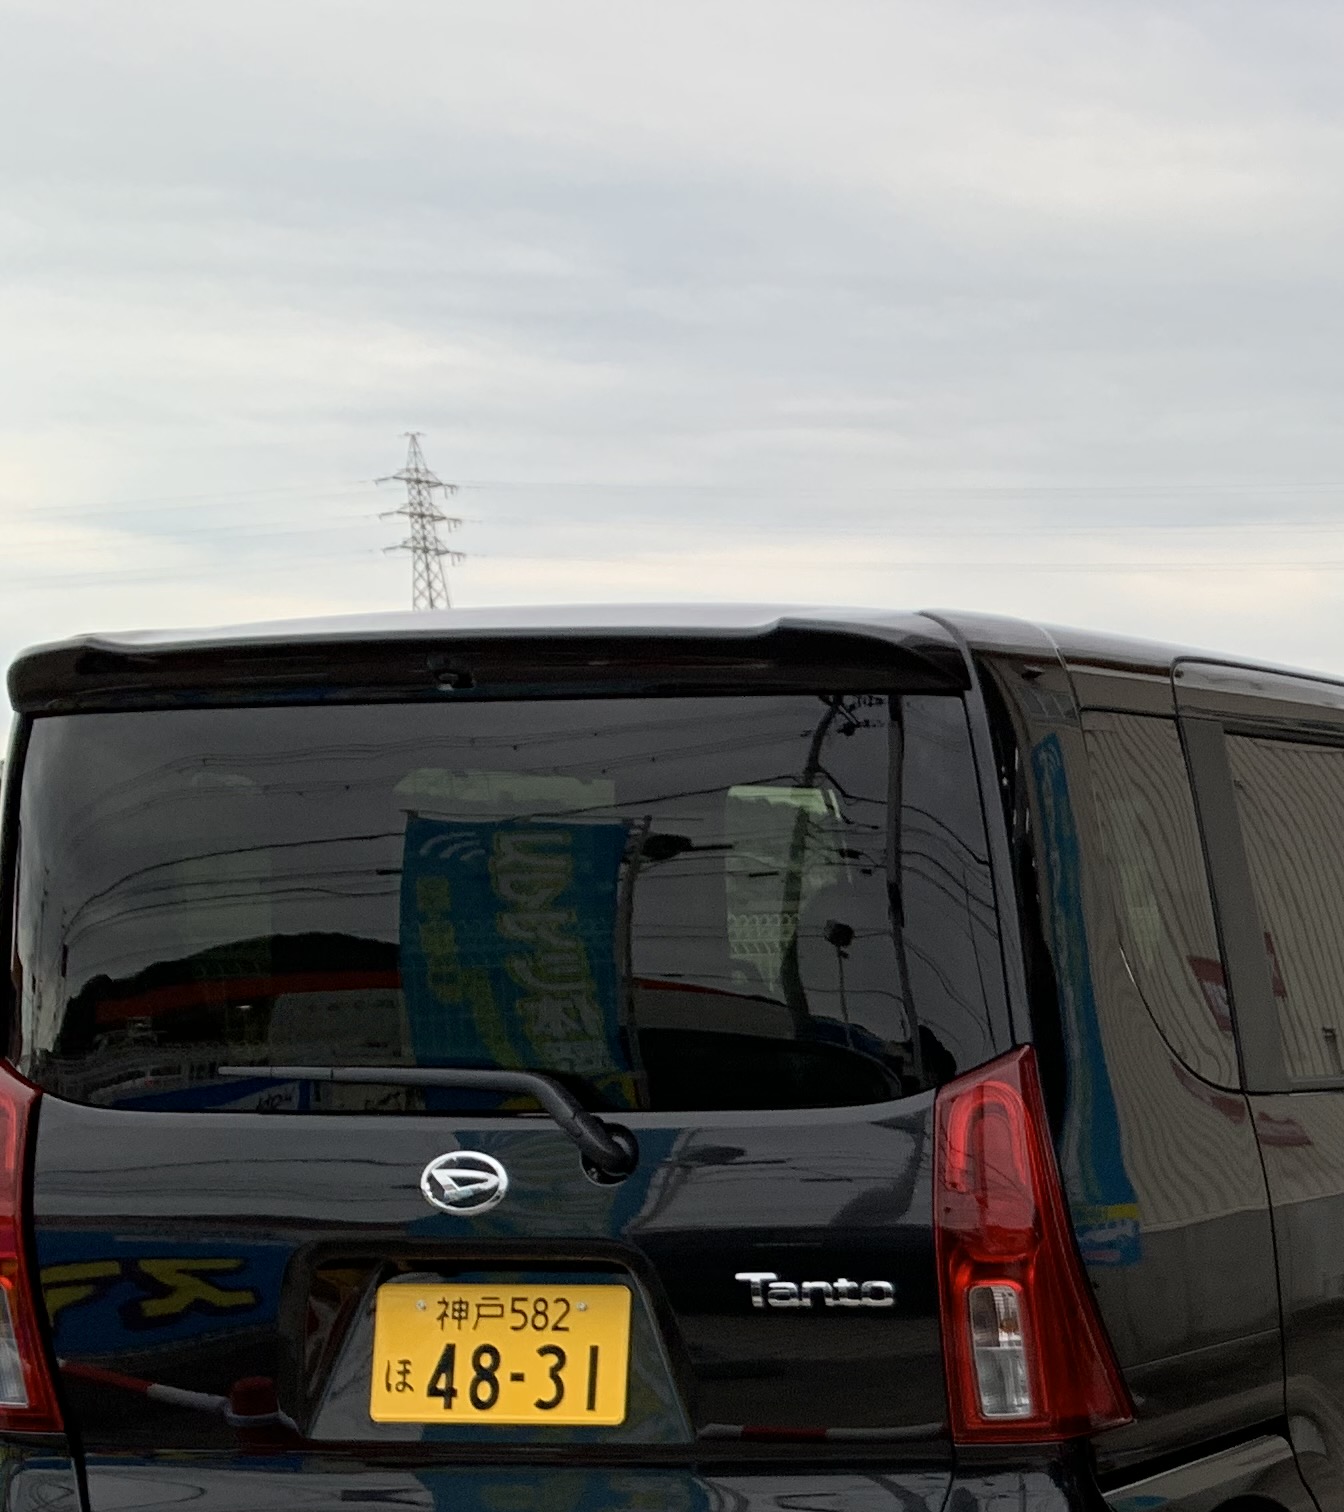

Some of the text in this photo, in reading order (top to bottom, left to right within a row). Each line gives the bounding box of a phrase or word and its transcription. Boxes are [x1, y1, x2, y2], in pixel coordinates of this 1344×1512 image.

[734, 1271, 895, 1308] Tanto
[385, 1342, 600, 1412] ほ 48-31
